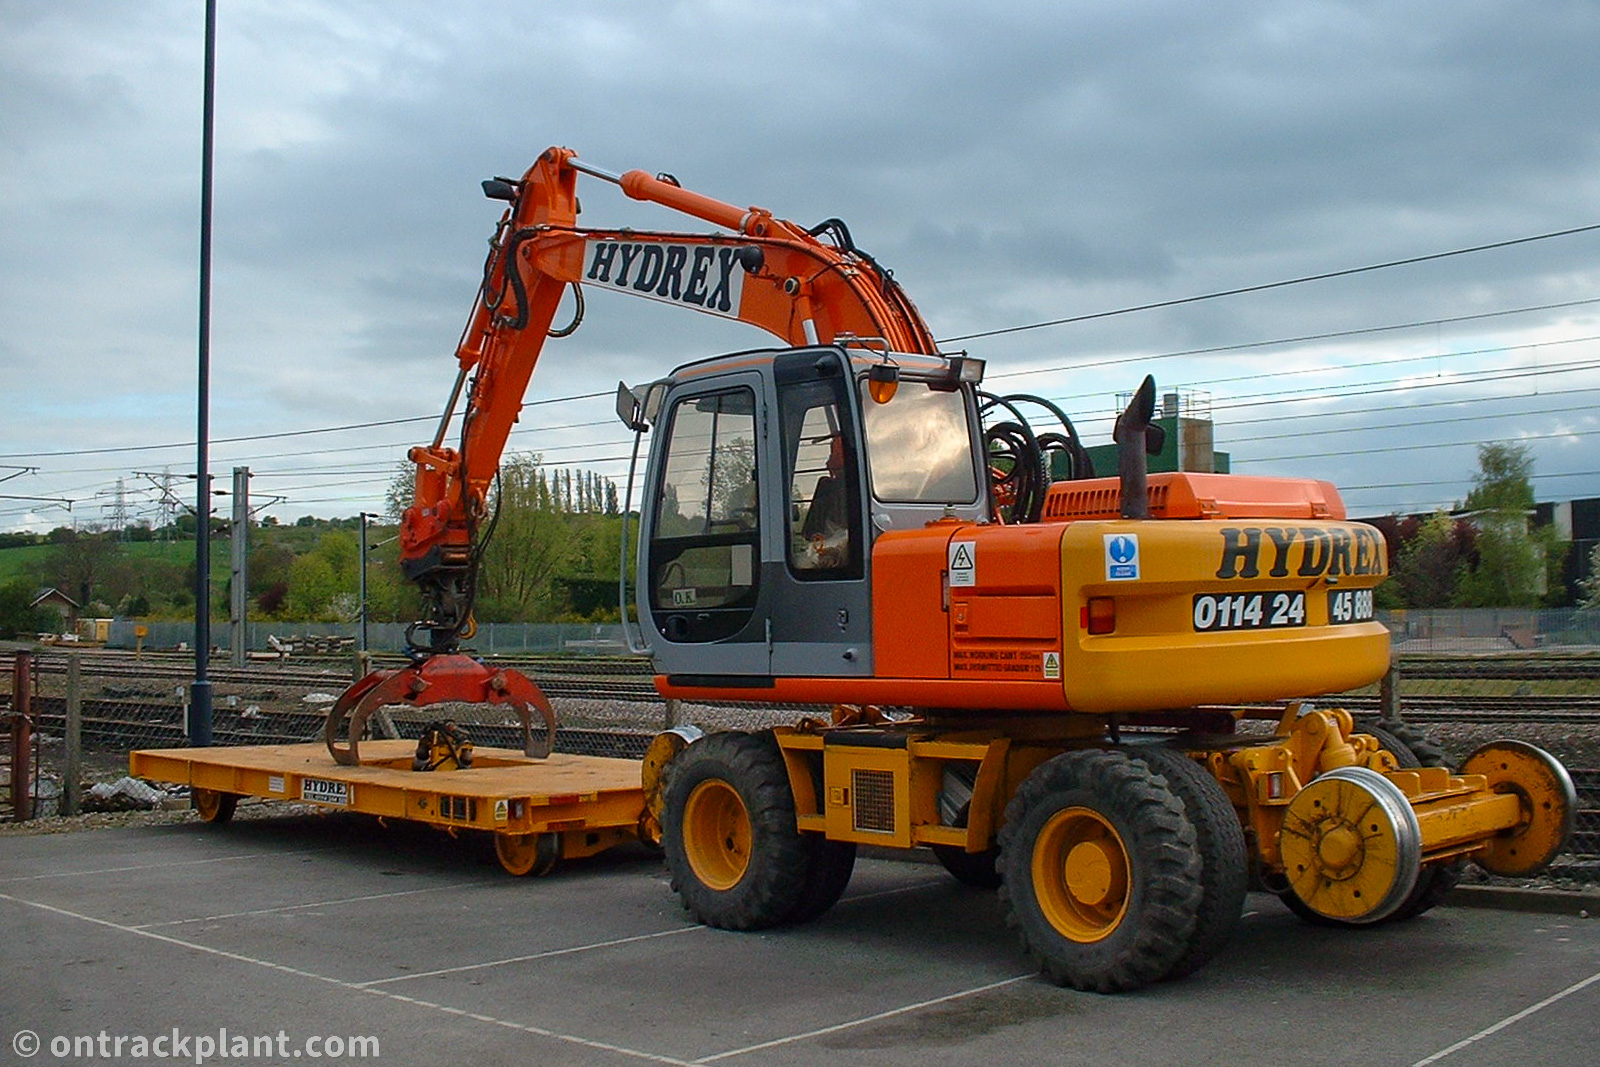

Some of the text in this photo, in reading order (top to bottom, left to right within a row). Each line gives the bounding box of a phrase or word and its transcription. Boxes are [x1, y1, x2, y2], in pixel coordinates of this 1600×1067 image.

[587, 243, 743, 312] HYDREX
[1216, 528, 1382, 578] HYDREX
[1194, 594, 1263, 629] 0114
[1271, 593, 1305, 625] 24
[1333, 591, 1352, 621] 45
